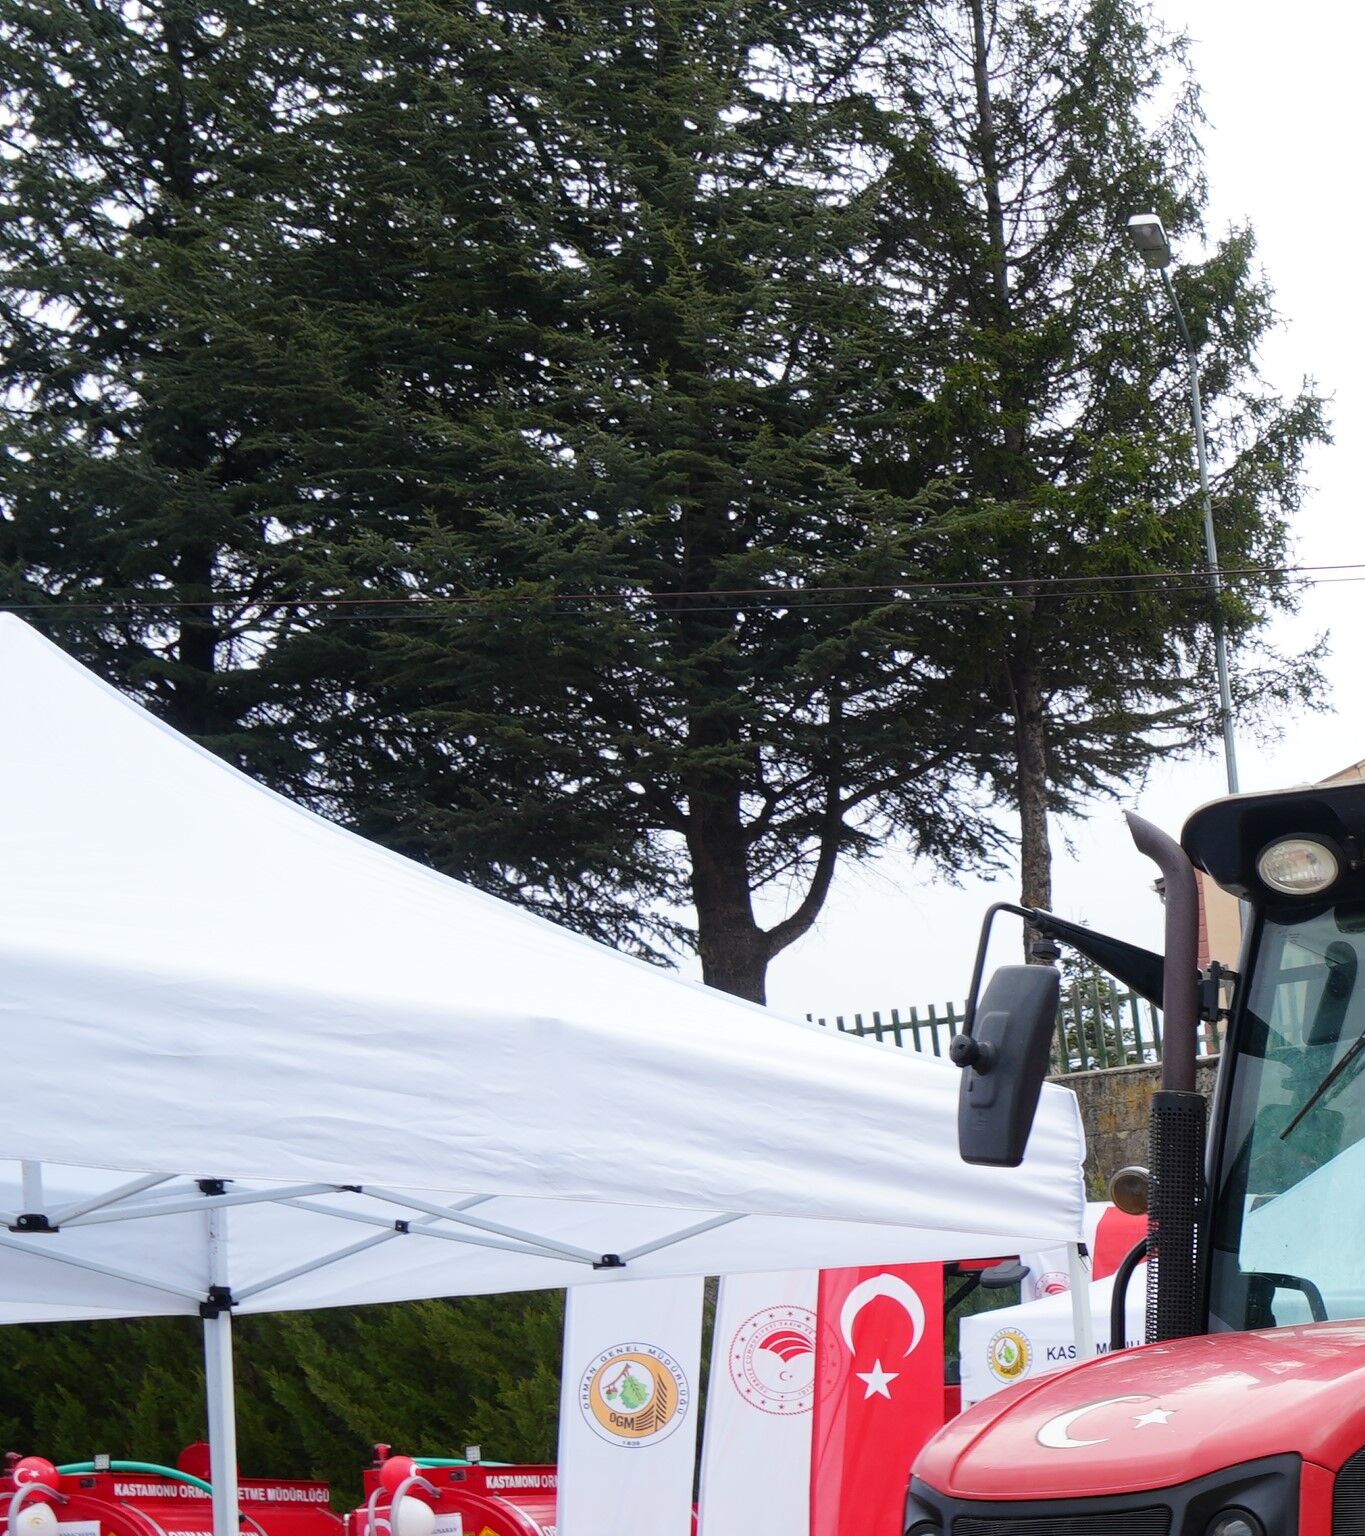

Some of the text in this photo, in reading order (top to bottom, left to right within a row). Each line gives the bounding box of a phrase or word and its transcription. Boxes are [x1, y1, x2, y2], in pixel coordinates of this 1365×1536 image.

[582, 1366, 596, 1410] ORMAN
[486, 1475, 540, 1489] KASTAMONU
[114, 1483, 177, 1498] KASTAMONU
[267, 1487, 330, 1503] MÜDÜRLÜĞÜ
